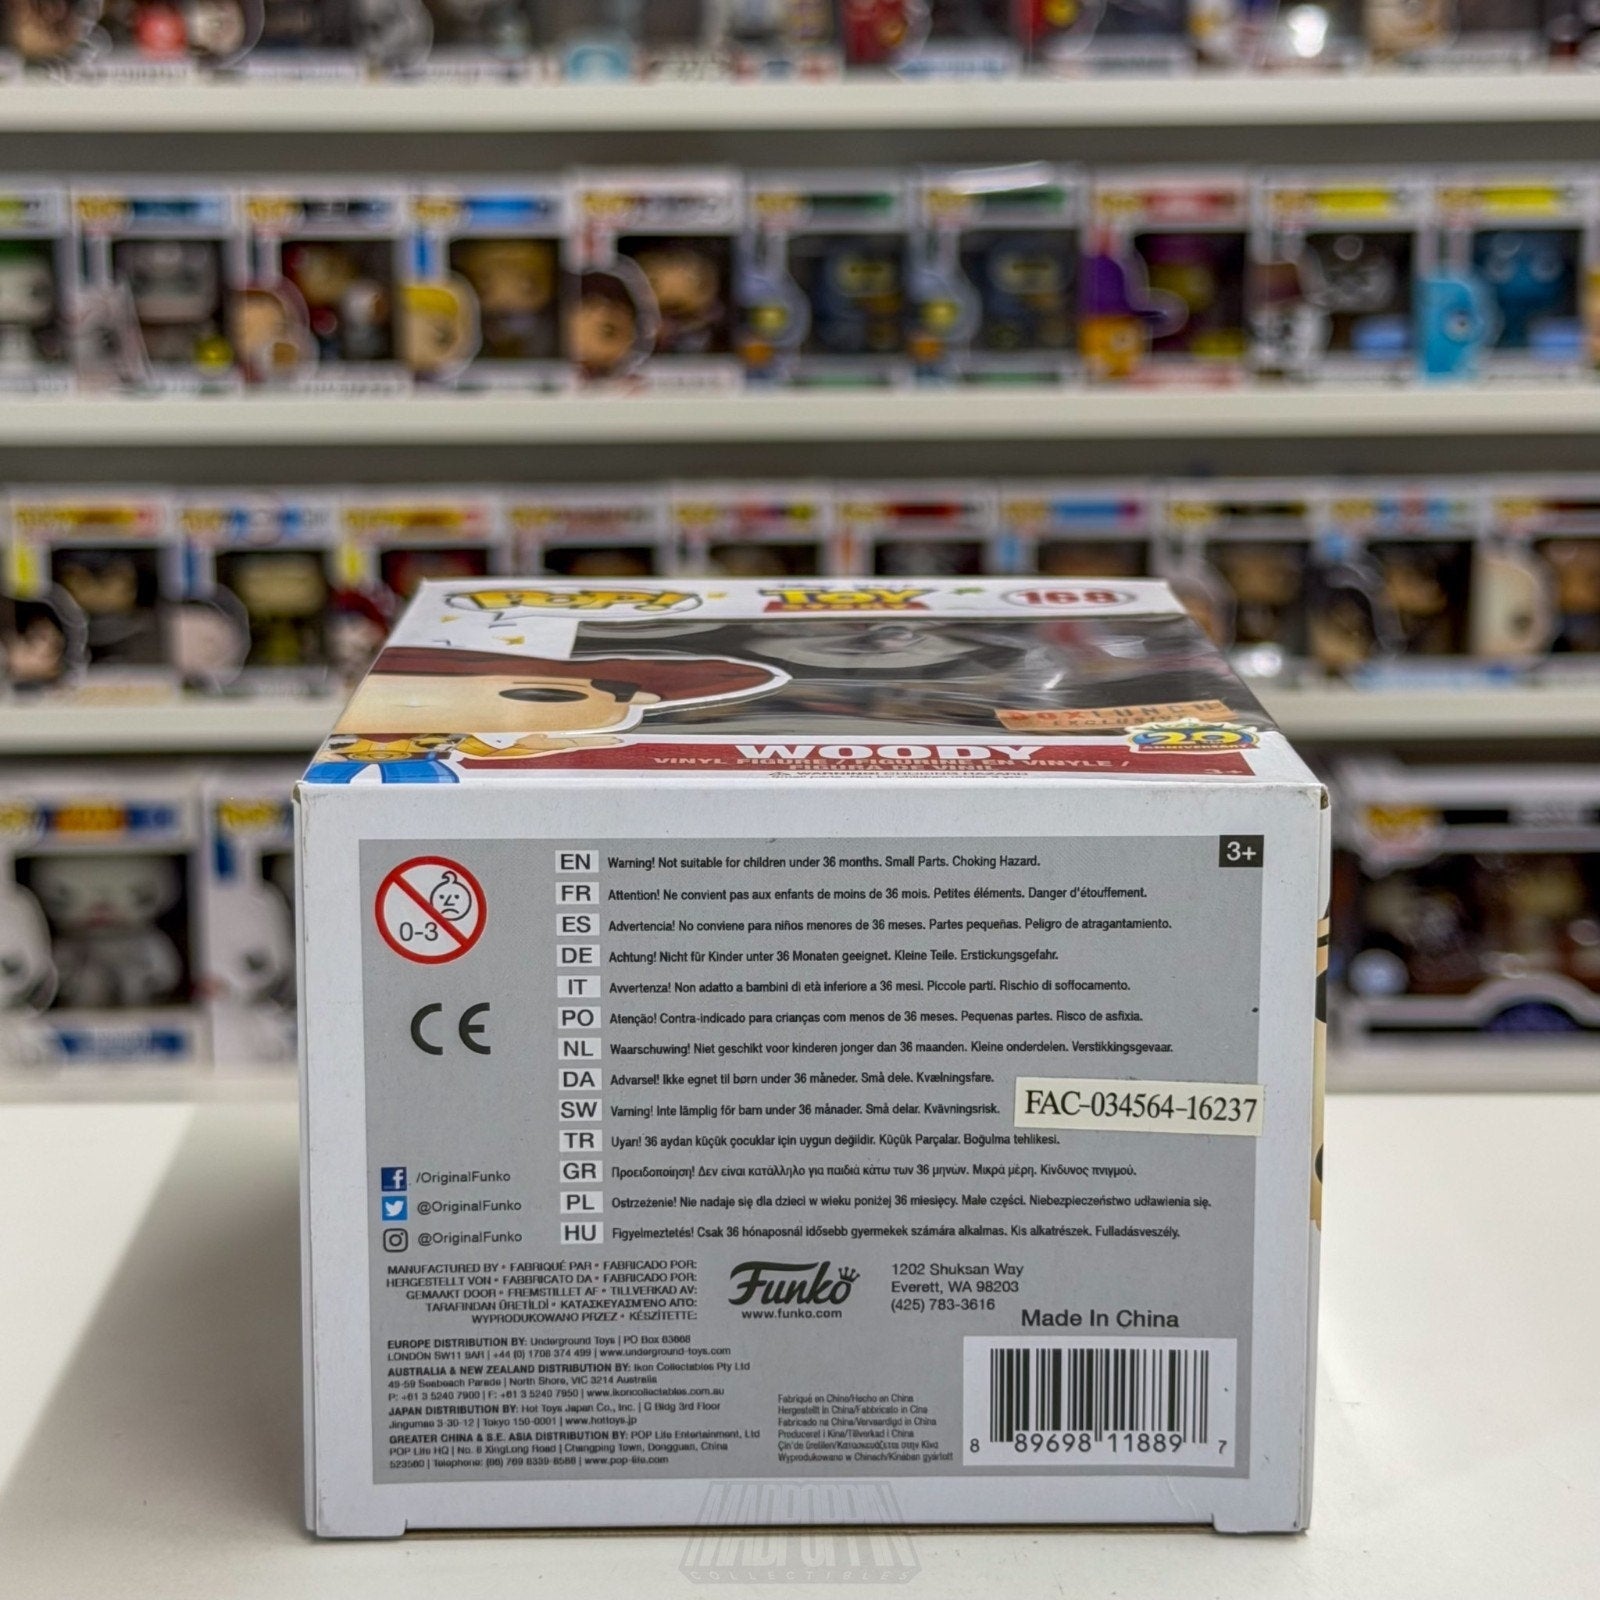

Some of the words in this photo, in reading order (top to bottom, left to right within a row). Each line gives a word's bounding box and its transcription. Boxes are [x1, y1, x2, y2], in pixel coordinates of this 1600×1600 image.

[470, 589, 688, 611] POP!
[759, 587, 938, 604] TOY
[1017, 591, 1118, 605] 168
[1148, 731, 1242, 745] 20
[735, 745, 1044, 760] WOODY
[653, 757, 729, 765] VINYL
[736, 758, 828, 766] FIGURE
[1022, 759, 1113, 768] VINYLE
[1226, 841, 1257, 861] 3+
[561, 854, 590, 870] EN
[607, 856, 655, 871] Warning!
[657, 856, 678, 868] Not
[679, 856, 723, 868] suitable
[725, 856, 741, 867] for
[742, 856, 786, 868] children
[788, 856, 820, 867] under
[822, 855, 836, 867] 36
[838, 855, 882, 867] months.
[884, 855, 915, 867] Small
[917, 855, 949, 867] Parts.
[951, 854, 996, 869] Choking
[999, 854, 1040, 866] Hazard.
[562, 886, 591, 902] FR
[607, 888, 660, 900] Attention!
[662, 888, 678, 900] Ne
[680, 889, 727, 900] convient
[728, 891, 749, 902] pas
[751, 891, 771, 899] aux
[774, 888, 814, 899] enfants
[816, 888, 831, 899] de
[833, 888, 866, 899] moins
[868, 887, 883, 899] de
[885, 887, 898, 899] 36
[901, 888, 930, 899] mois.
[933, 887, 971, 899] Petites
[973, 886, 1025, 898] éléments.
[1028, 886, 1067, 901] Danger
[1069, 886, 1147, 898] d'étouffement.
[399, 921, 439, 942] 0-3
[562, 916, 591, 933] ES
[562, 947, 592, 964] DE
[608, 951, 657, 965] Achtung!
[659, 951, 688, 962] Nicht
[690, 950, 706, 962] für
[708, 950, 743, 962] Kinder
[745, 950, 774, 961] unter
[776, 950, 790, 961] 36
[792, 950, 839, 961] Monaten
[841, 950, 891, 963] geeignet.
[894, 949, 927, 960] Kleine
[929, 948, 957, 960] Teile.
[960, 948, 1058, 962] Erstickungsgefahr.
[568, 978, 588, 994] IT
[562, 1009, 594, 1026] PO
[410, 1001, 491, 1055] CE
[564, 1040, 594, 1056] NL
[609, 1042, 690, 1057] Waarschuwing!
[693, 1042, 715, 1054] Niet
[717, 1042, 763, 1056] geschikt
[765, 1044, 790, 1053] voor
[791, 1041, 838, 1053] kinderen
[839, 1042, 874, 1056] jonger
[876, 1041, 897, 1052] dan
[899, 1041, 913, 1052] 36
[915, 1040, 967, 1052] maanden.
[970, 1040, 1004, 1052] Kleine
[1005, 1040, 1069, 1052] onderdelen.
[1071, 1040, 1173, 1055] Verstikkingsgevaar.
[563, 1071, 595, 1087] DA
[560, 1102, 598, 1118] SW
[1024, 1090, 1258, 1123] FAC-034564-16237
[564, 1132, 594, 1148] TR
[563, 1162, 596, 1180] GR
[417, 1200, 522, 1216] @OriginalFunko
[566, 1194, 594, 1210] PL
[418, 1231, 523, 1246] @OriginalFunko
[565, 1224, 596, 1242] HU
[696, 1226, 724, 1237] Csak
[726, 1225, 739, 1237] 36
[850, 1224, 908, 1239] gyermekek
[957, 1224, 1008, 1236] alkalmas.
[1010, 1224, 1027, 1236] Kis
[892, 1263, 925, 1275] 1202
[929, 1262, 989, 1275] Shuksan
[993, 1262, 1024, 1278] Way
[728, 1260, 856, 1305] Funko
[890, 1280, 943, 1294] Everett,
[947, 1280, 972, 1292] WA
[975, 1280, 1019, 1292] 98203
[741, 1307, 842, 1319] www.funko.com
[890, 1298, 925, 1313] (425)
[928, 1297, 995, 1310] 783-3616
[1021, 1308, 1082, 1327] Made
[1089, 1309, 1109, 1327] In
[1115, 1309, 1179, 1328] China
[970, 1438, 981, 1453] 8
[1013, 1433, 1092, 1453] 89698
[1107, 1433, 1183, 1453] 11889
[1217, 1440, 1228, 1454] 7
